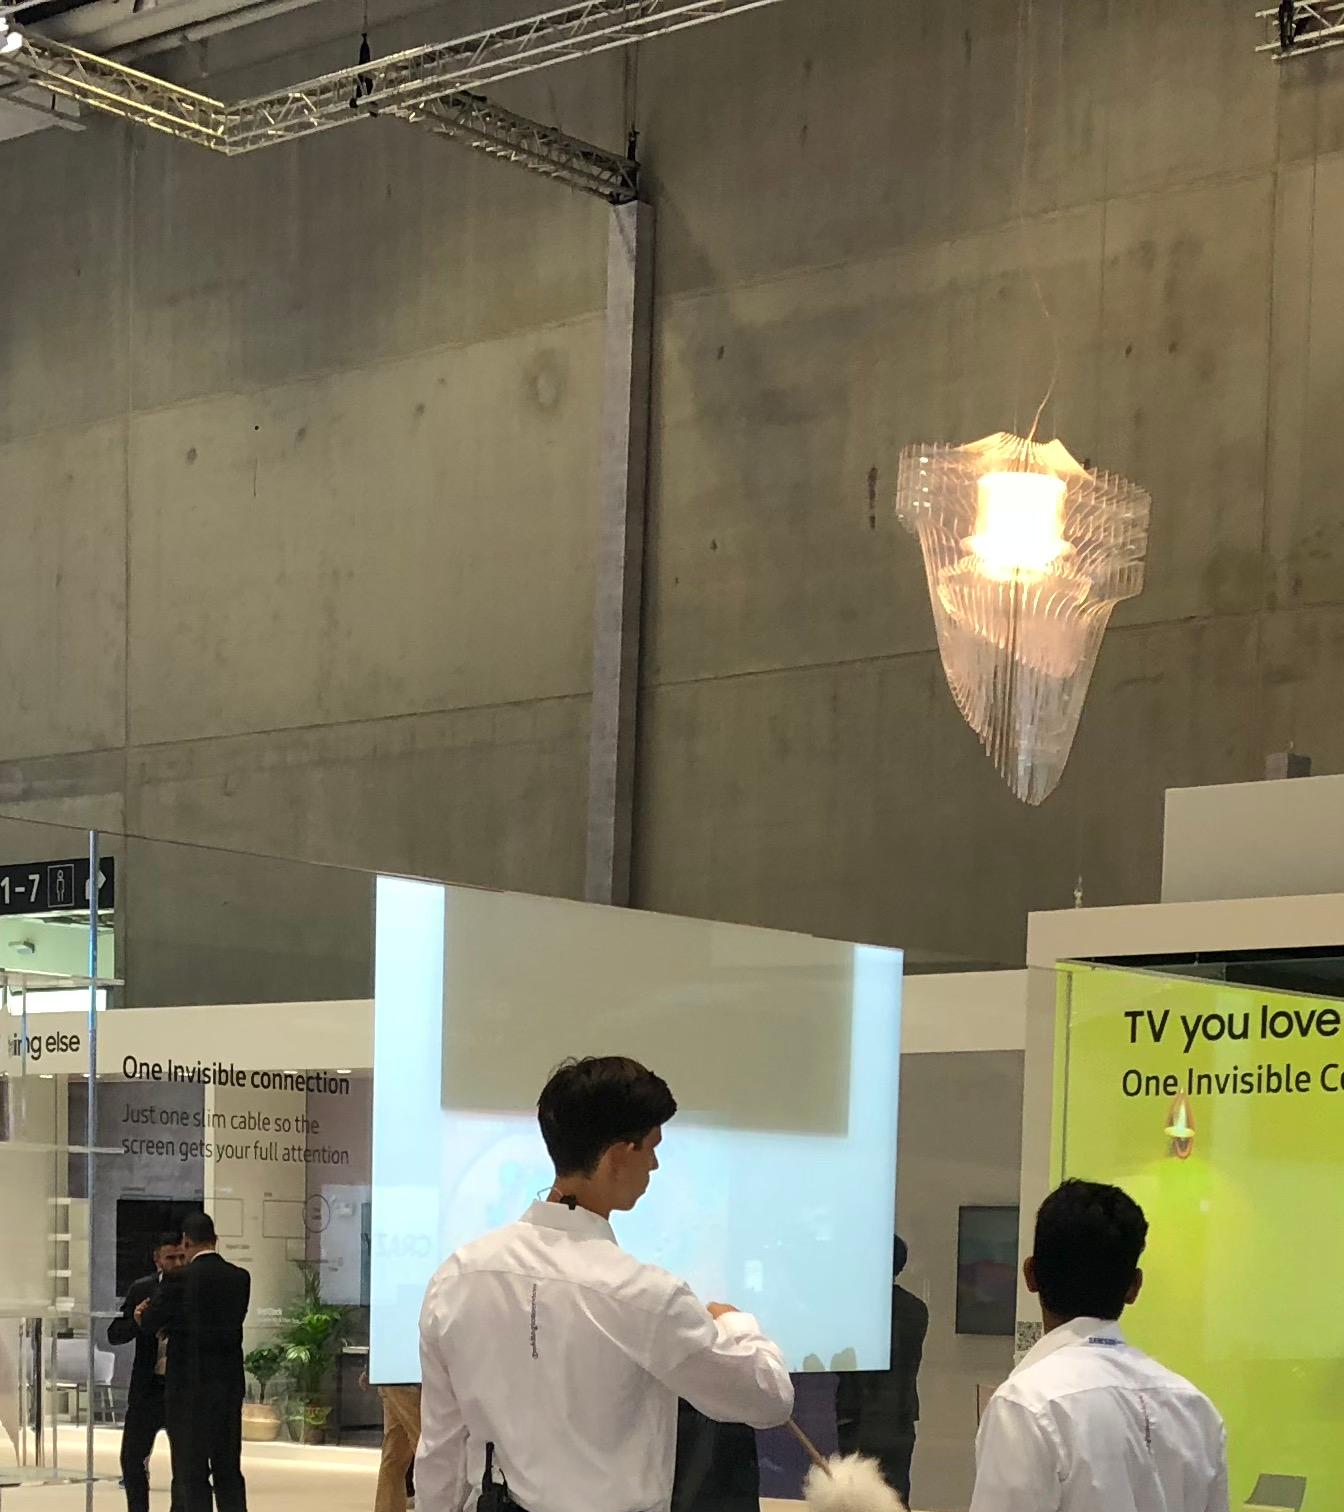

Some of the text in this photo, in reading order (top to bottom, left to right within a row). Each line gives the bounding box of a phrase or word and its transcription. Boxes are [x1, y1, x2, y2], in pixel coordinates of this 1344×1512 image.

[45, 1031, 80, 1053] else
[1123, 1009, 1169, 1043] TV
[1180, 1009, 1250, 1054] you
[1260, 1005, 1341, 1039] love
[122, 1055, 350, 1095] One Invisible connection
[1122, 1068, 1178, 1097] One
[1187, 1063, 1311, 1095] Invisible
[121, 1104, 320, 1135] Just one slim cable so the
[121, 1138, 350, 1165] screen gets your full attention
